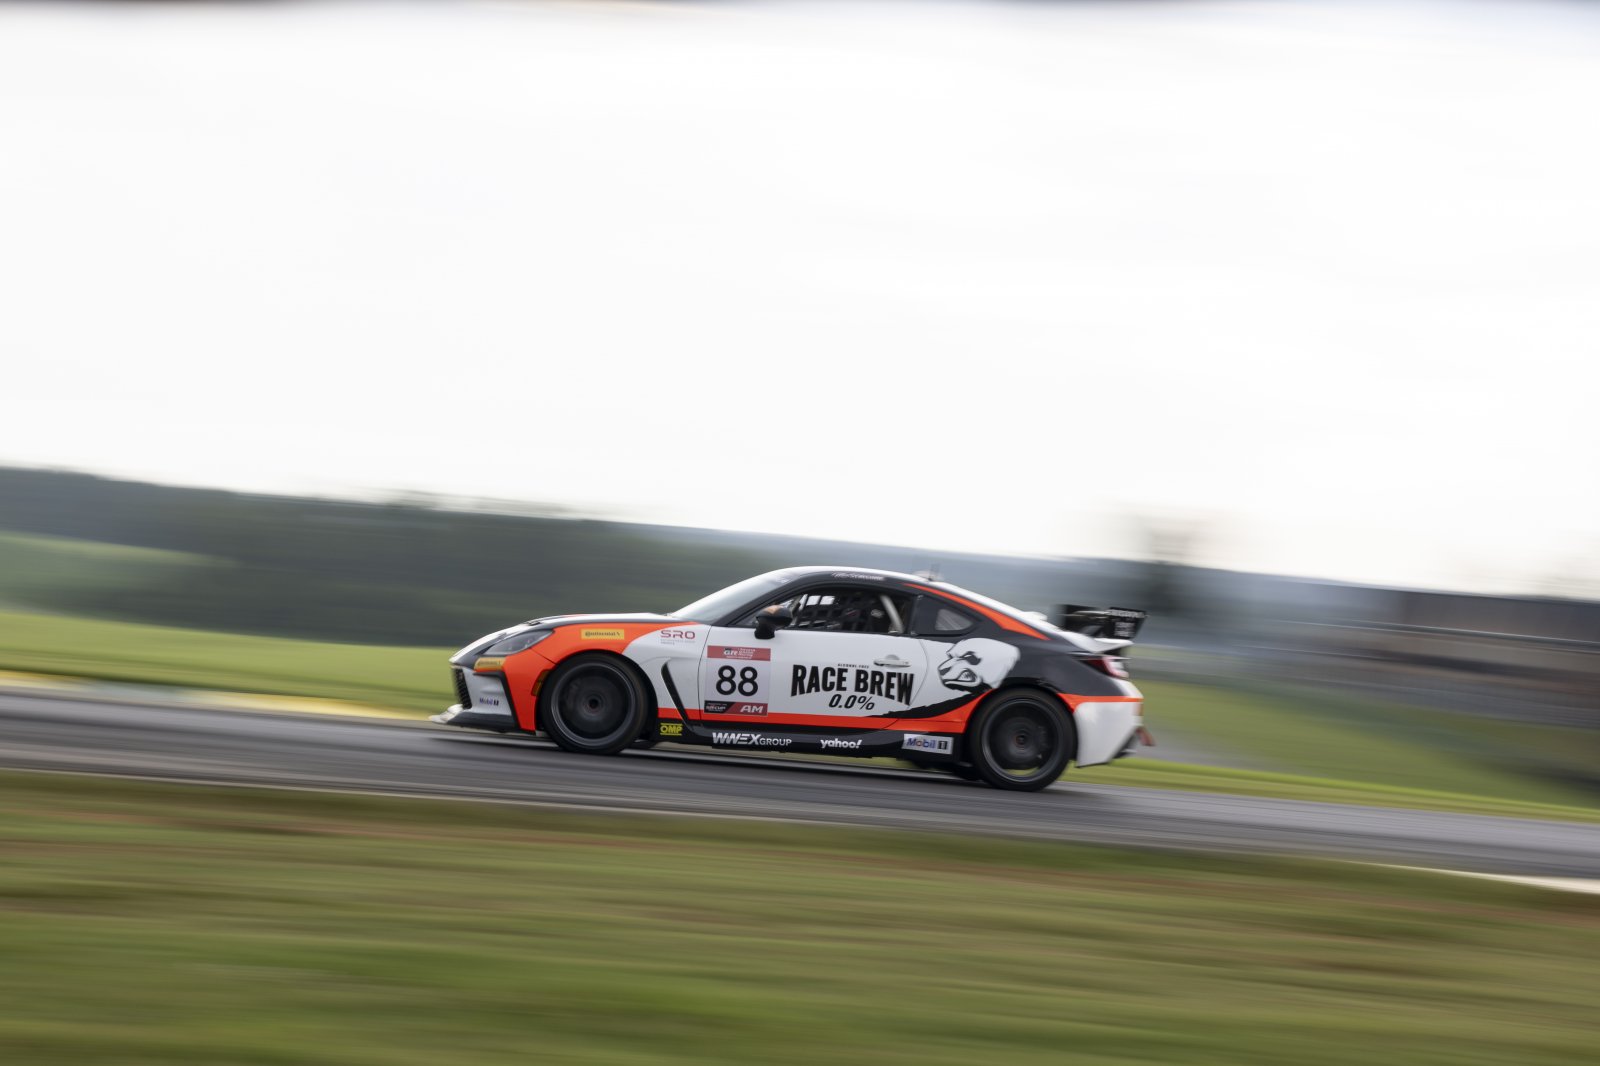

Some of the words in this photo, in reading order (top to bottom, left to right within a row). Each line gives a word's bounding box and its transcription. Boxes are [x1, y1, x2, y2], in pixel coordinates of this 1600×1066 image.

[660, 630, 696, 640] SRO
[716, 665, 758, 696] 88
[791, 664, 848, 698] RACE
[854, 668, 914, 706] BREW
[828, 694, 875, 710] 0.0%
[740, 704, 763, 713] AM
[660, 724, 682, 734] OMP
[760, 738, 792, 746] GROUP
[820, 738, 862, 749] yahoo!
[906, 738, 936, 749] Mobil
